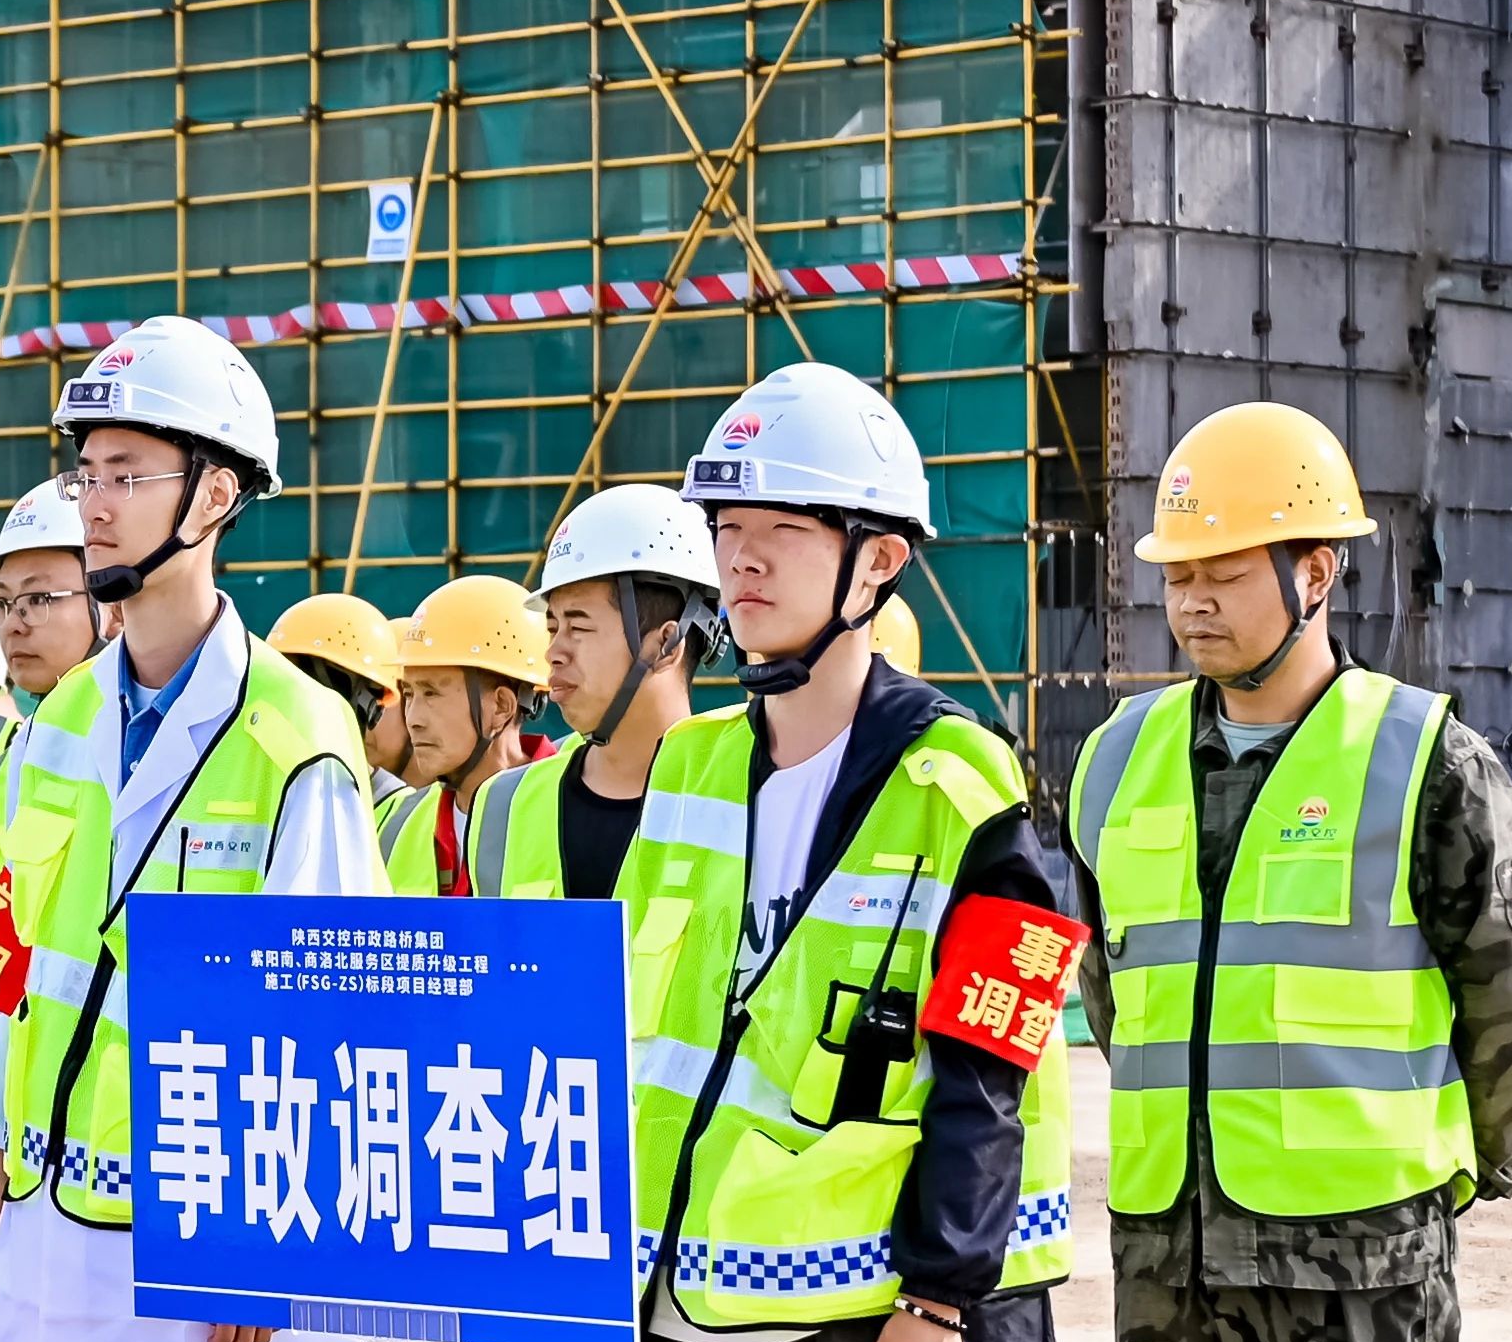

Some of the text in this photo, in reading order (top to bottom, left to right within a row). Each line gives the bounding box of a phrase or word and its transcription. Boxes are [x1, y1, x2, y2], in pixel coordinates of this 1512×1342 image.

[290, 927, 445, 951] 陕西交控市政路桥集团
[250, 949, 490, 975] 紫阳南、商洛北服务区提质升级工程
[263, 971, 474, 998] 施工(FSG-ZS)标段项目经理部
[956, 971, 1059, 1057] 调查
[146, 1029, 611, 1261] 事故调查组
